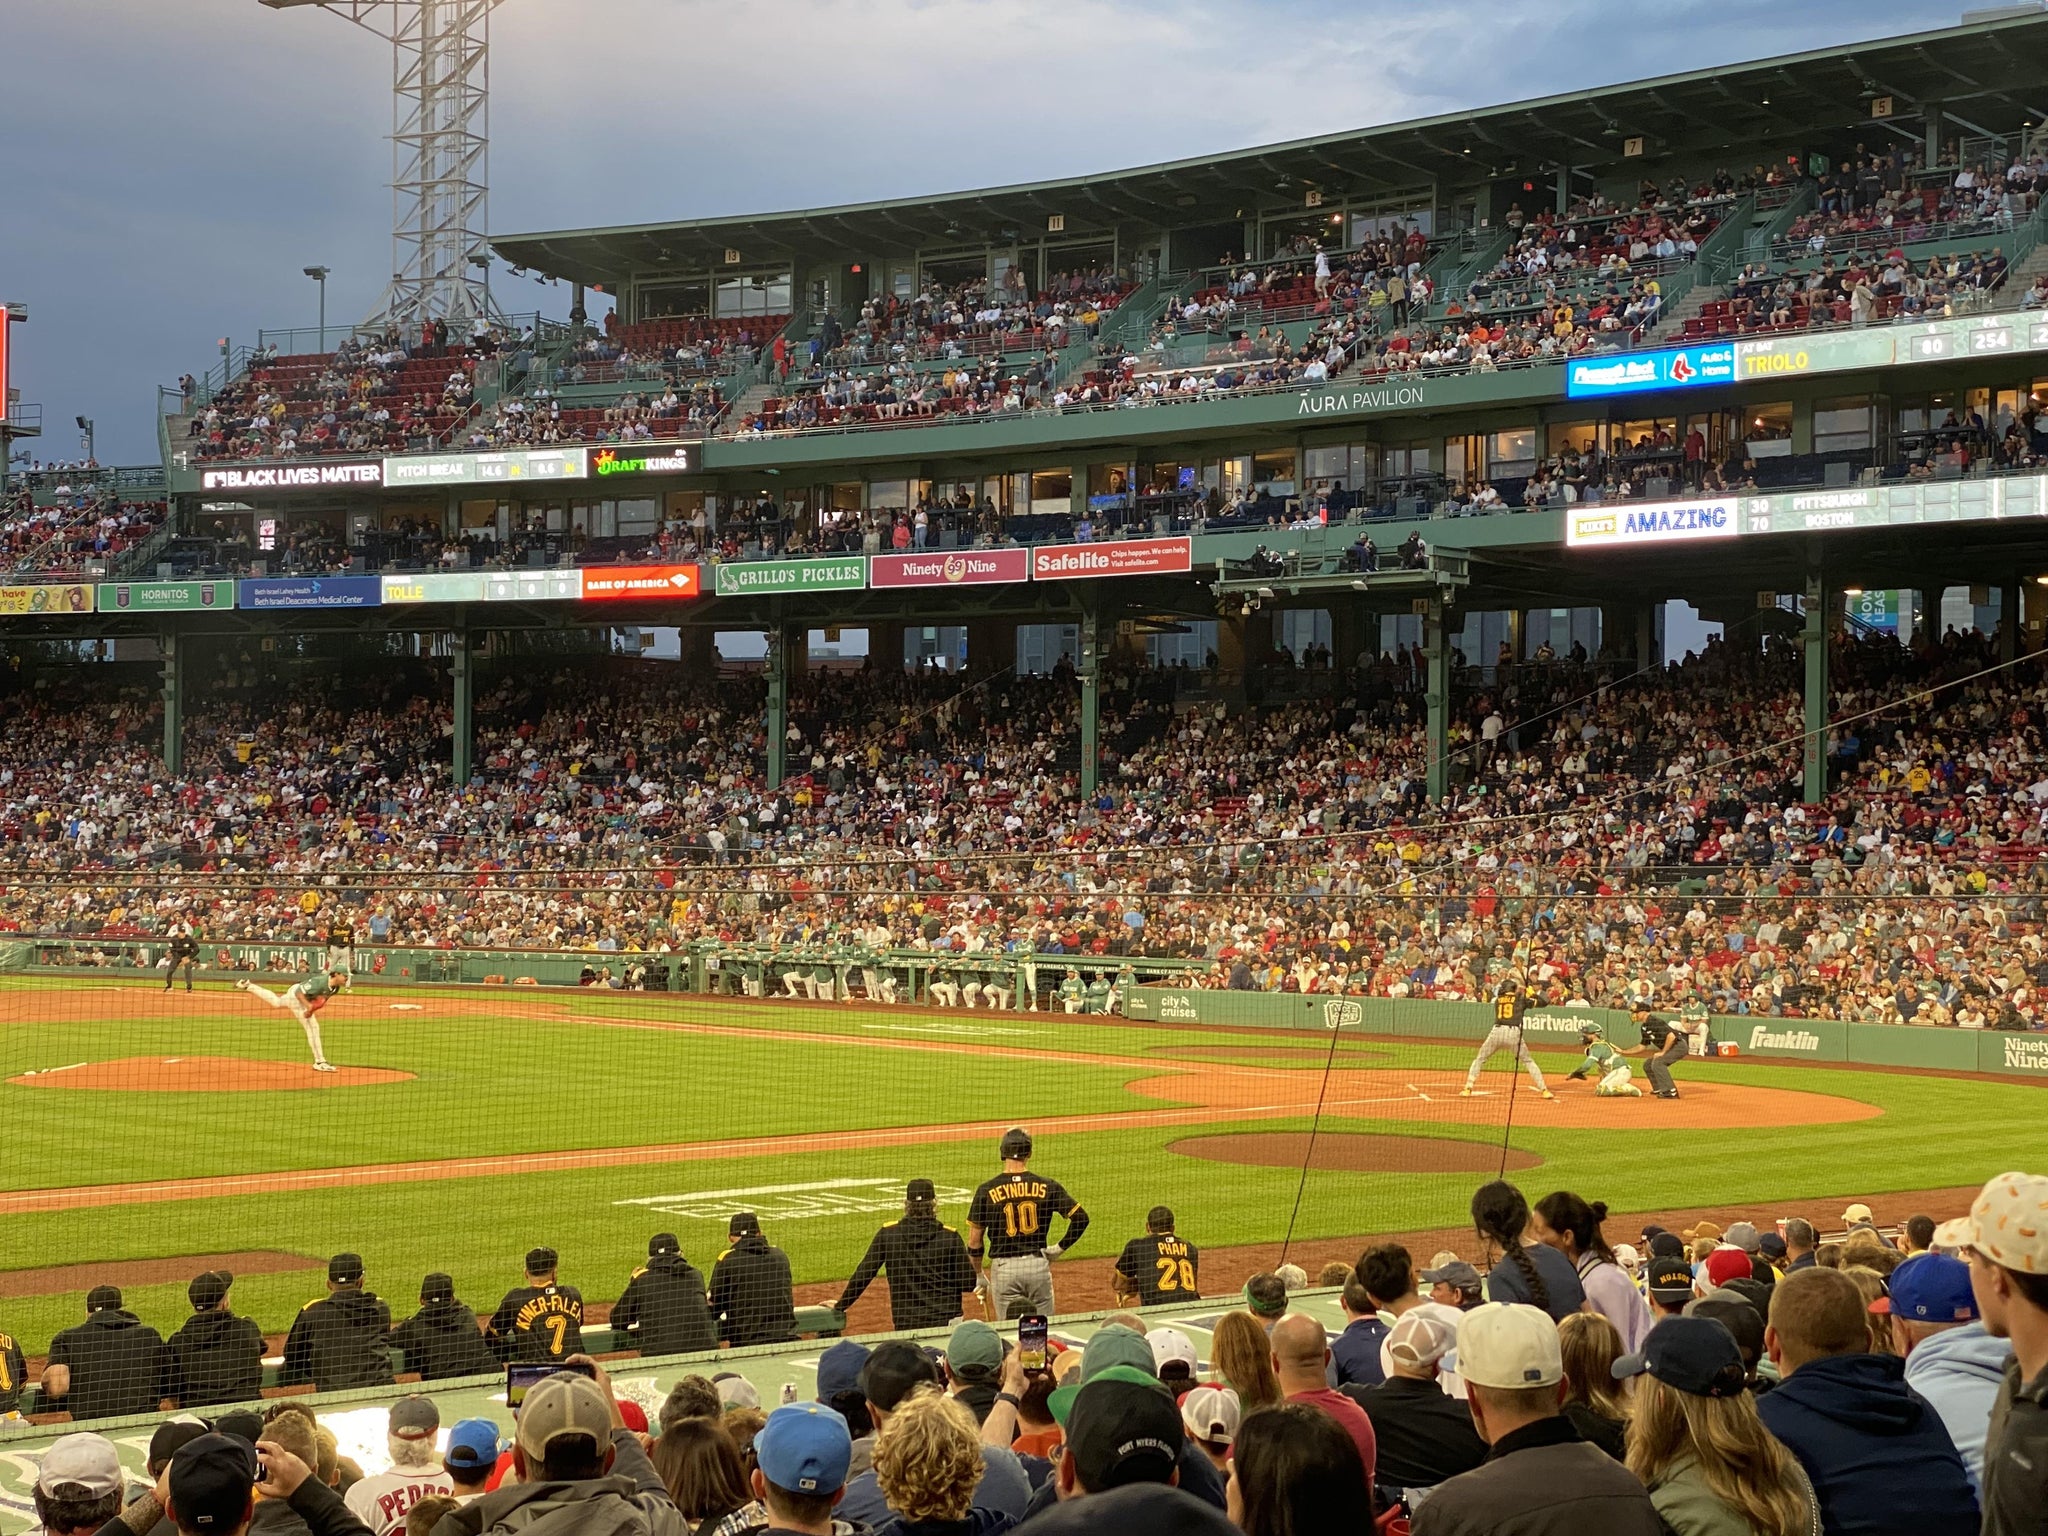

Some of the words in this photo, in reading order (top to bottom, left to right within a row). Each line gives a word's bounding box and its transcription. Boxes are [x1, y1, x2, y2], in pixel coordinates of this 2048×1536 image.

[1879, 101, 1885, 113] 5
[1630, 142, 1636, 154] 7
[1310, 192, 1317, 204] 9
[1052, 217, 1060, 229] 11
[728, 250, 737, 261] 13
[1975, 331, 2007, 350] 254
[1742, 344, 1755, 354] AT
[1745, 352, 1809, 374] TRIOLO
[1353, 387, 1423, 409] PAVILION
[397, 465, 427, 478] PITCH
[598, 457, 687, 475] DRAFTKINGS
[228, 470, 276, 487] BLACK
[278, 468, 319, 485] LIVES
[322, 465, 381, 484] MATTER
[1751, 499, 1769, 514] 30
[1793, 492, 1868, 510] PITTSBURGH
[1625, 507, 1727, 533] AMAZING
[1751, 517, 1769, 531] 70
[1805, 511, 1854, 528] BOSTON
[1111, 550, 1127, 559] Chips
[1128, 548, 1151, 557] happen.
[1173, 545, 1187, 554] help.
[902, 563, 943, 577] Ninety
[967, 560, 997, 573] Nine
[1037, 551, 1109, 572] Safelite
[1125, 557, 1159, 567] safelite.com
[739, 569, 796, 585] GRILLO'S
[802, 566, 860, 582] PICKLES
[294, 587, 311, 595] Health
[587, 581, 613, 590] BANK
[614, 580, 626, 589] OF
[627, 579, 669, 588] AMERICA
[2, 589, 26, 598] have
[141, 589, 189, 600] HORNITOS
[387, 586, 424, 599] TOLLE
[255, 597, 269, 606] Beth
[270, 597, 285, 606] Israel
[286, 597, 317, 605] Deaconess
[318, 596, 342, 604] Medical
[343, 595, 363, 604] Center
[1861, 590, 1873, 623] NOW
[1122, 623, 1130, 633] 13
[1161, 995, 1180, 1009] city
[1161, 1007, 1196, 1018] cruises
[1498, 1003, 1514, 1019] 19
[1749, 1026, 1819, 1051] Franklin
[2004, 1037, 2048, 1055] Ninety
[1721, 1045, 1729, 1055] G
[2004, 1051, 2048, 1069] Nine
[988, 1182, 1047, 1204] REYNOLDS
[1003, 1201, 1038, 1237] 10
[1157, 1242, 1187, 1257] PHAM
[1156, 1257, 1196, 1291] 28
[545, 1315, 567, 1354] 7
[1136, 1438, 1157, 1448] MYERS
